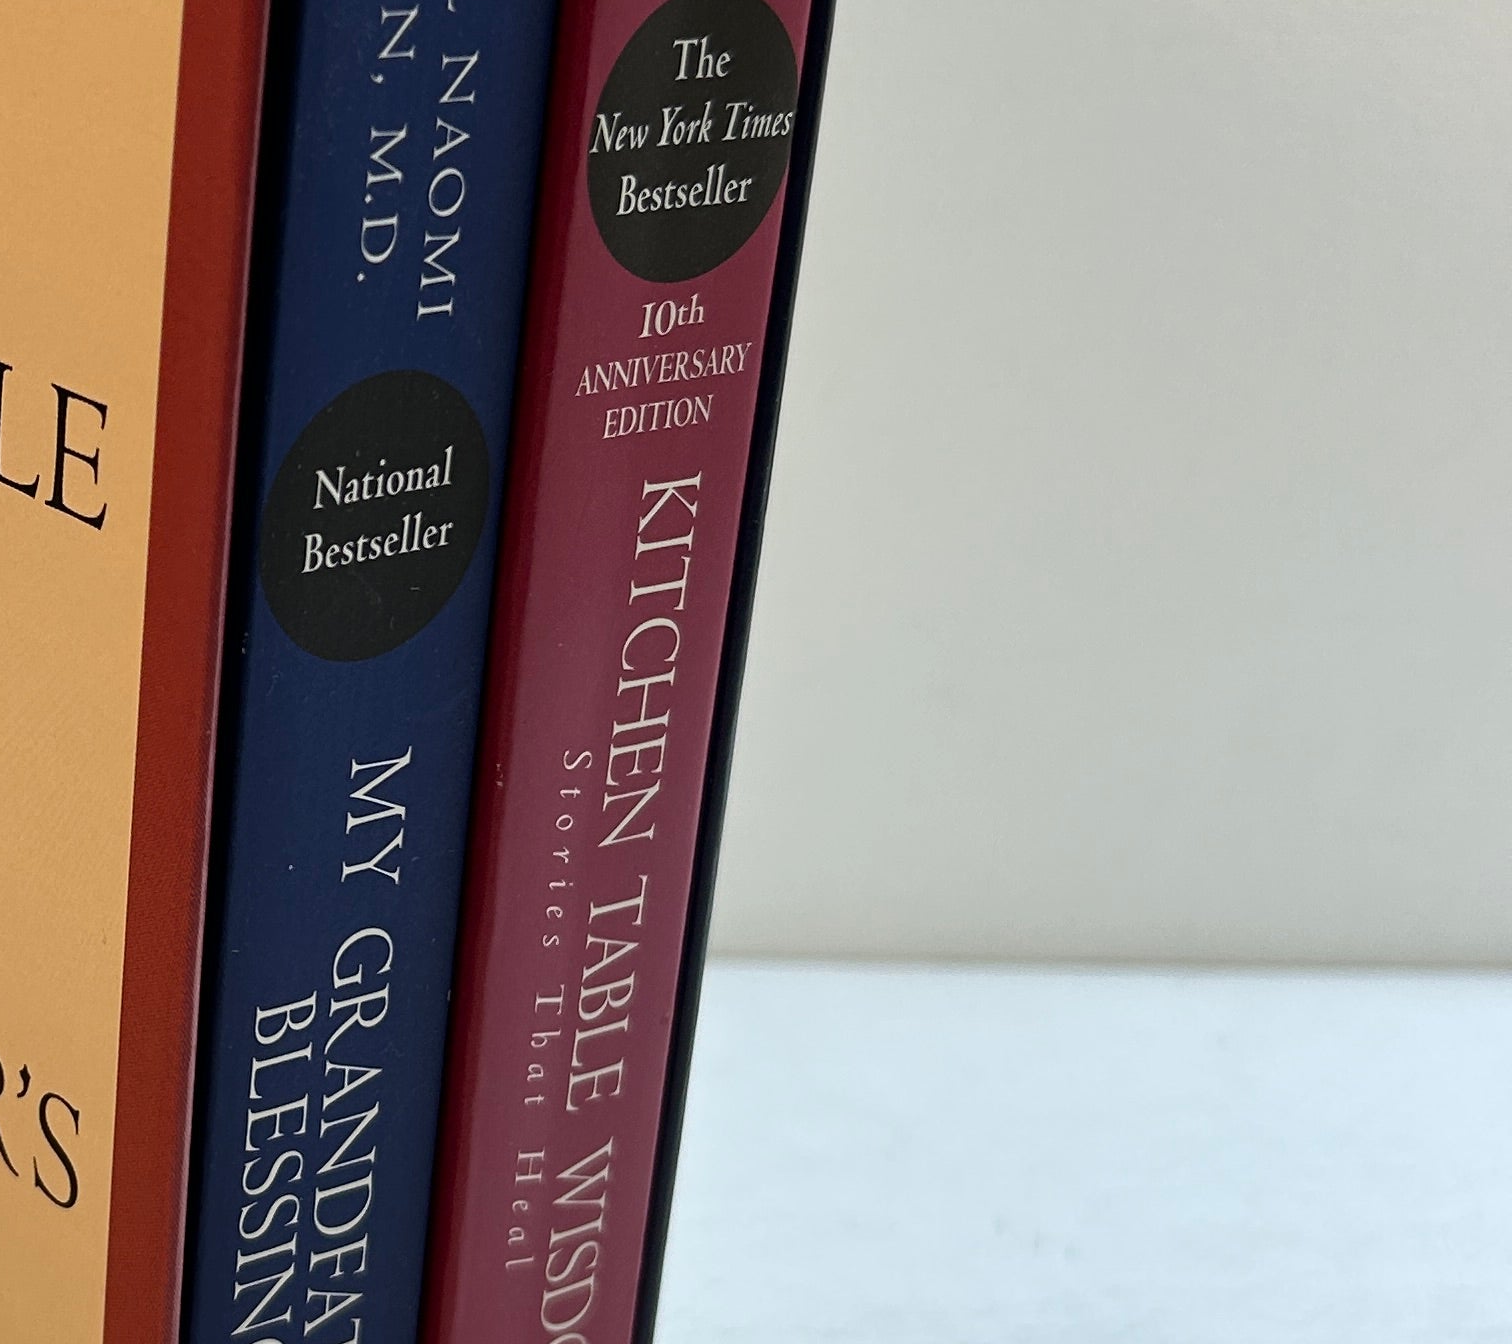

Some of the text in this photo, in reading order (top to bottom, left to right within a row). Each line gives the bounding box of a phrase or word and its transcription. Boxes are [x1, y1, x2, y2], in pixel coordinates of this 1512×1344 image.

[673, 36, 730, 81] The
[590, 101, 794, 154] New York Times
[357, 127, 406, 282] M.D.
[417, 51, 479, 321] NAOMI
[616, 164, 752, 216] Bestseller
[639, 293, 705, 339] 10th
[575, 342, 752, 397] ANNIVERSARY
[603, 393, 714, 439] EDITION
[313, 445, 453, 509] National
[302, 513, 453, 574] Bestseller
[597, 471, 702, 848] KITCHEN
[341, 745, 412, 885] MY
[506, 749, 592, 1271] Stories That Heal
[566, 874, 648, 1114] TABLE
